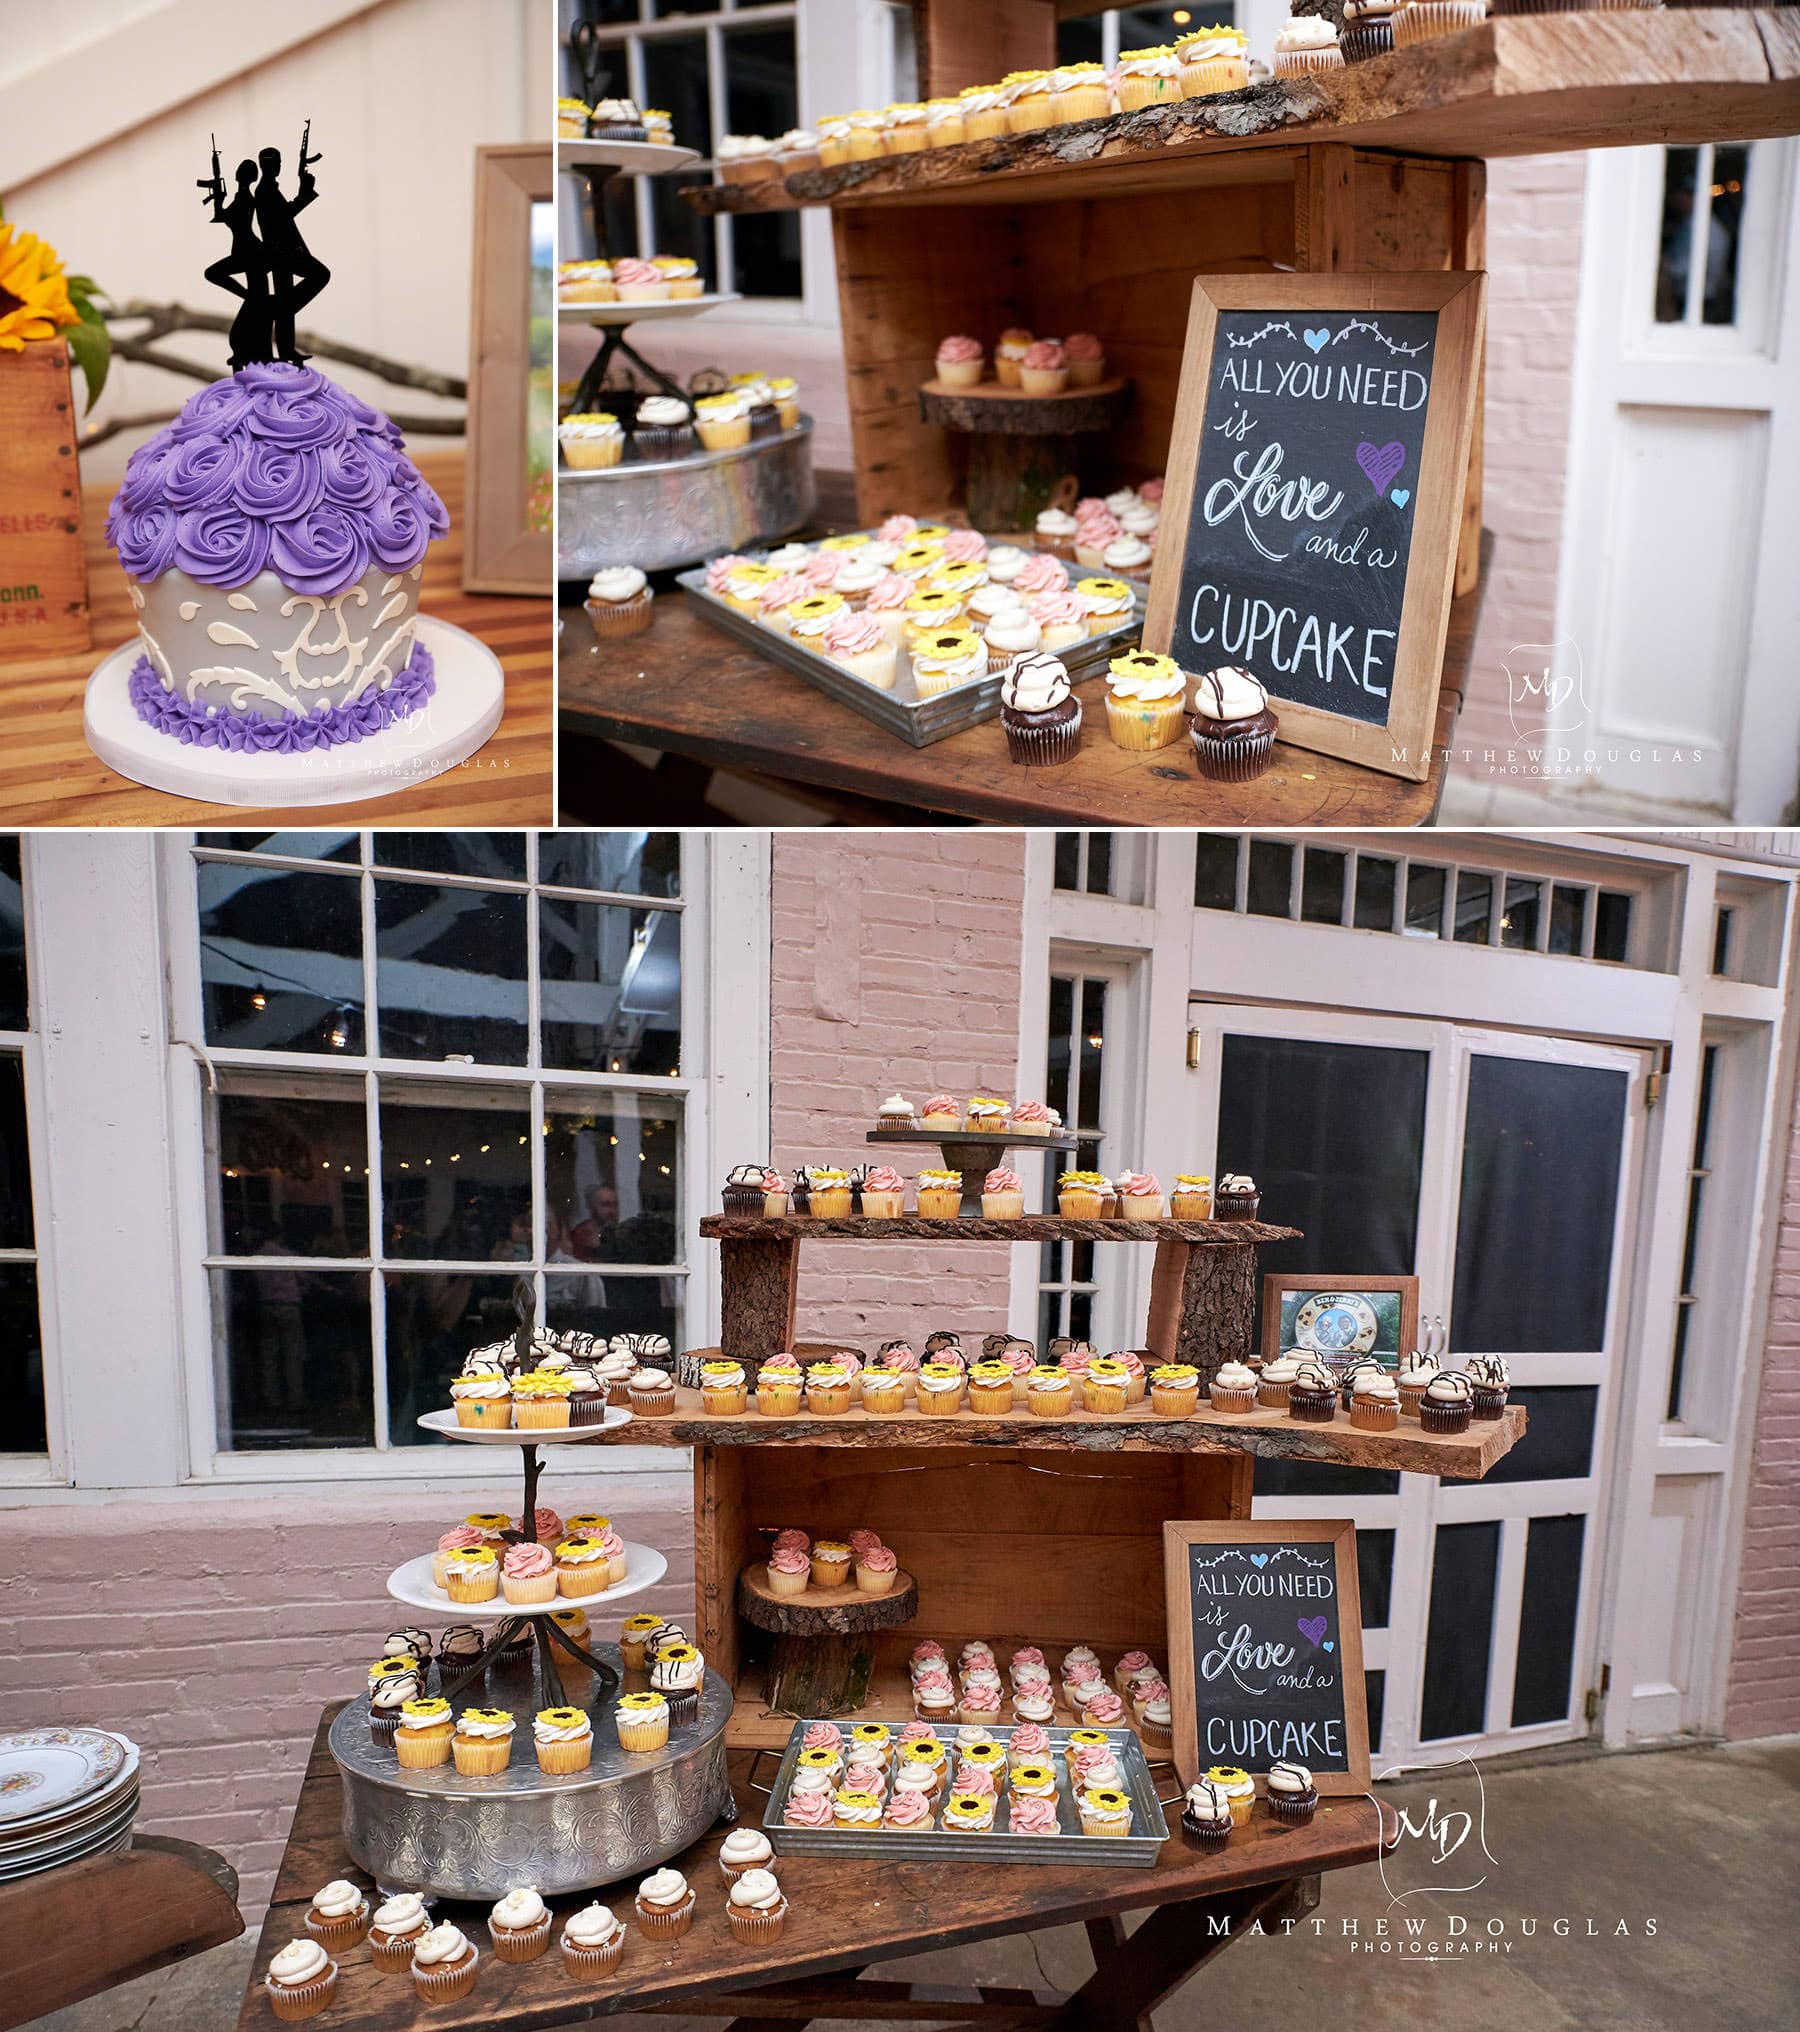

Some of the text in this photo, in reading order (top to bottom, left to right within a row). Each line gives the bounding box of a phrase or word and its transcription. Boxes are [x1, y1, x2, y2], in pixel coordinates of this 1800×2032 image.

[1219, 358, 1428, 411] ALL YOU NEED
[1214, 402, 1257, 441] is
[1204, 442, 1344, 562] Love
[1305, 528, 1397, 568] and a
[1190, 585, 1396, 698] CUPCAKE
[1197, 1574, 1333, 1599] ALL YOU NEED
[1198, 1601, 1229, 1626] is
[1201, 1623, 1296, 1695] Love
[1276, 1666, 1334, 1690] and a
[1207, 1717, 1343, 1758] CUPCAKE
